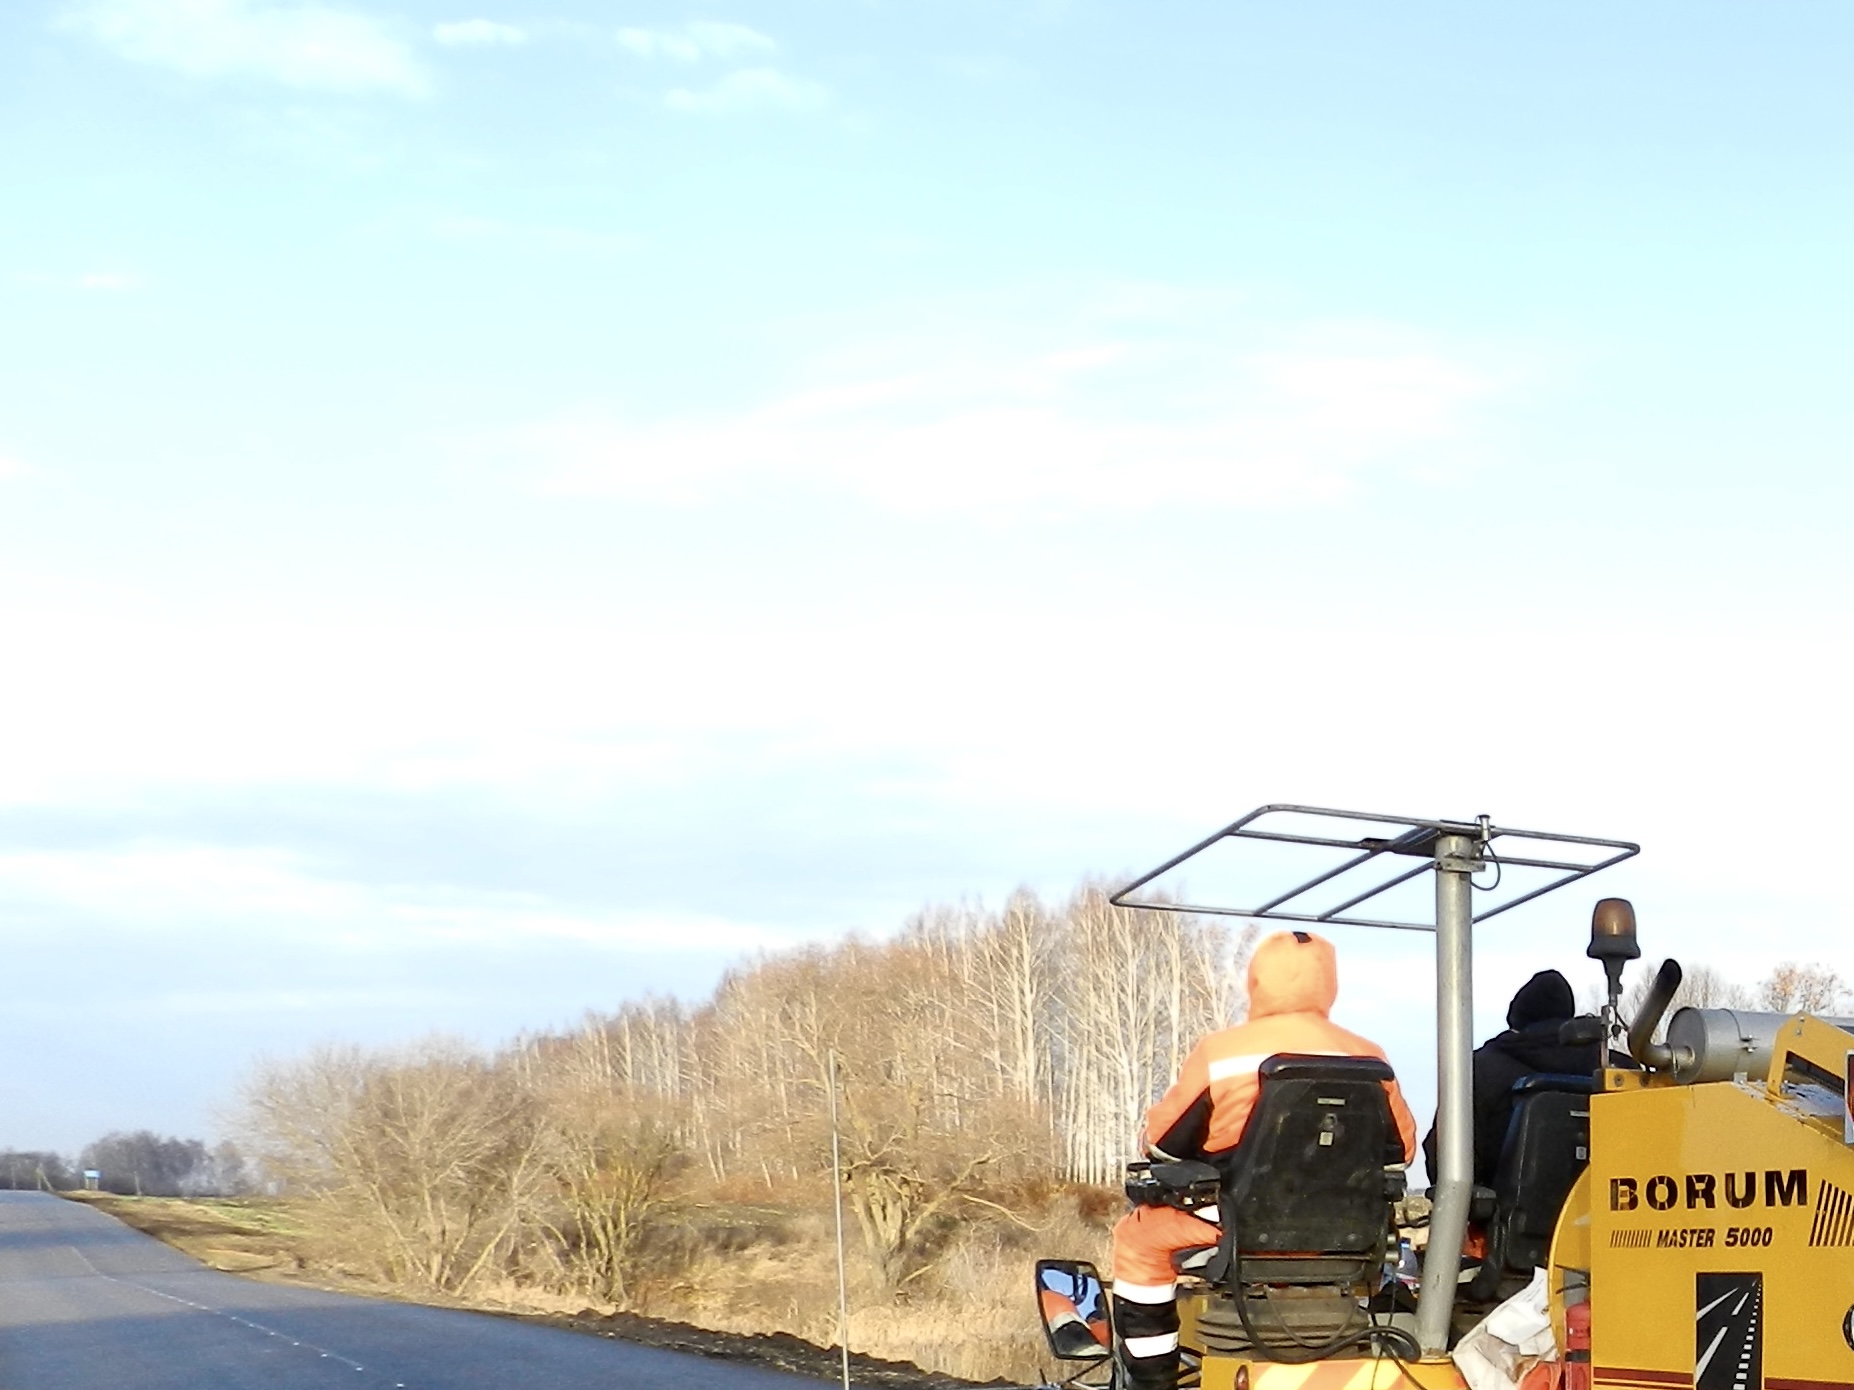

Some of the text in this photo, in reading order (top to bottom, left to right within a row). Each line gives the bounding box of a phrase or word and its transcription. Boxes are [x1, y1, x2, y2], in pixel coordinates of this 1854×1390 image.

[1610, 1169, 1808, 1212] BORUM
[1656, 1227, 1773, 1248] MASTER 5000
